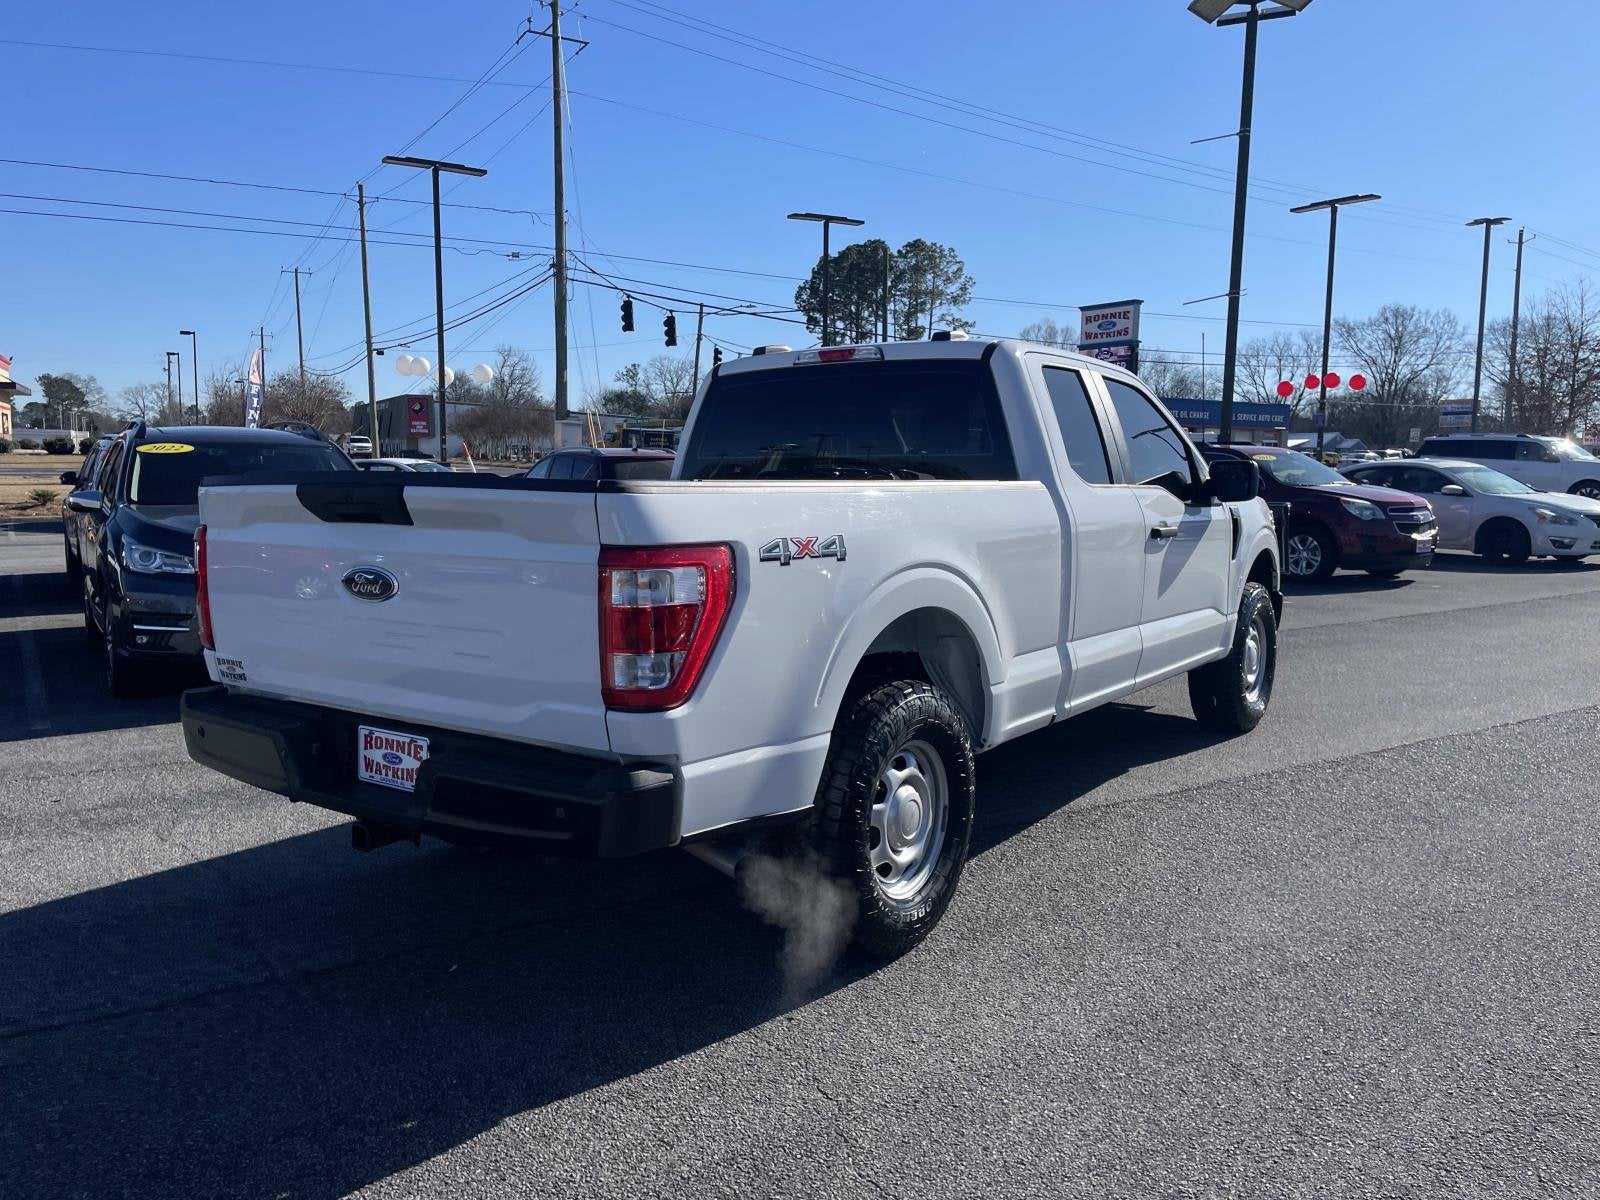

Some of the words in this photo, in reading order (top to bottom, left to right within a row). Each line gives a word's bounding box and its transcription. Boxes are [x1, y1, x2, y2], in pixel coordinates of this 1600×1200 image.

[1085, 311, 1130, 325] RONNIE
[1085, 327, 1130, 340] WATKINS
[1237, 413, 1257, 421] SERVICE
[352, 572, 383, 594] Ford
[216, 657, 244, 670] RONNIE
[220, 668, 247, 681] WATKINS
[364, 733, 423, 762] RONNIE
